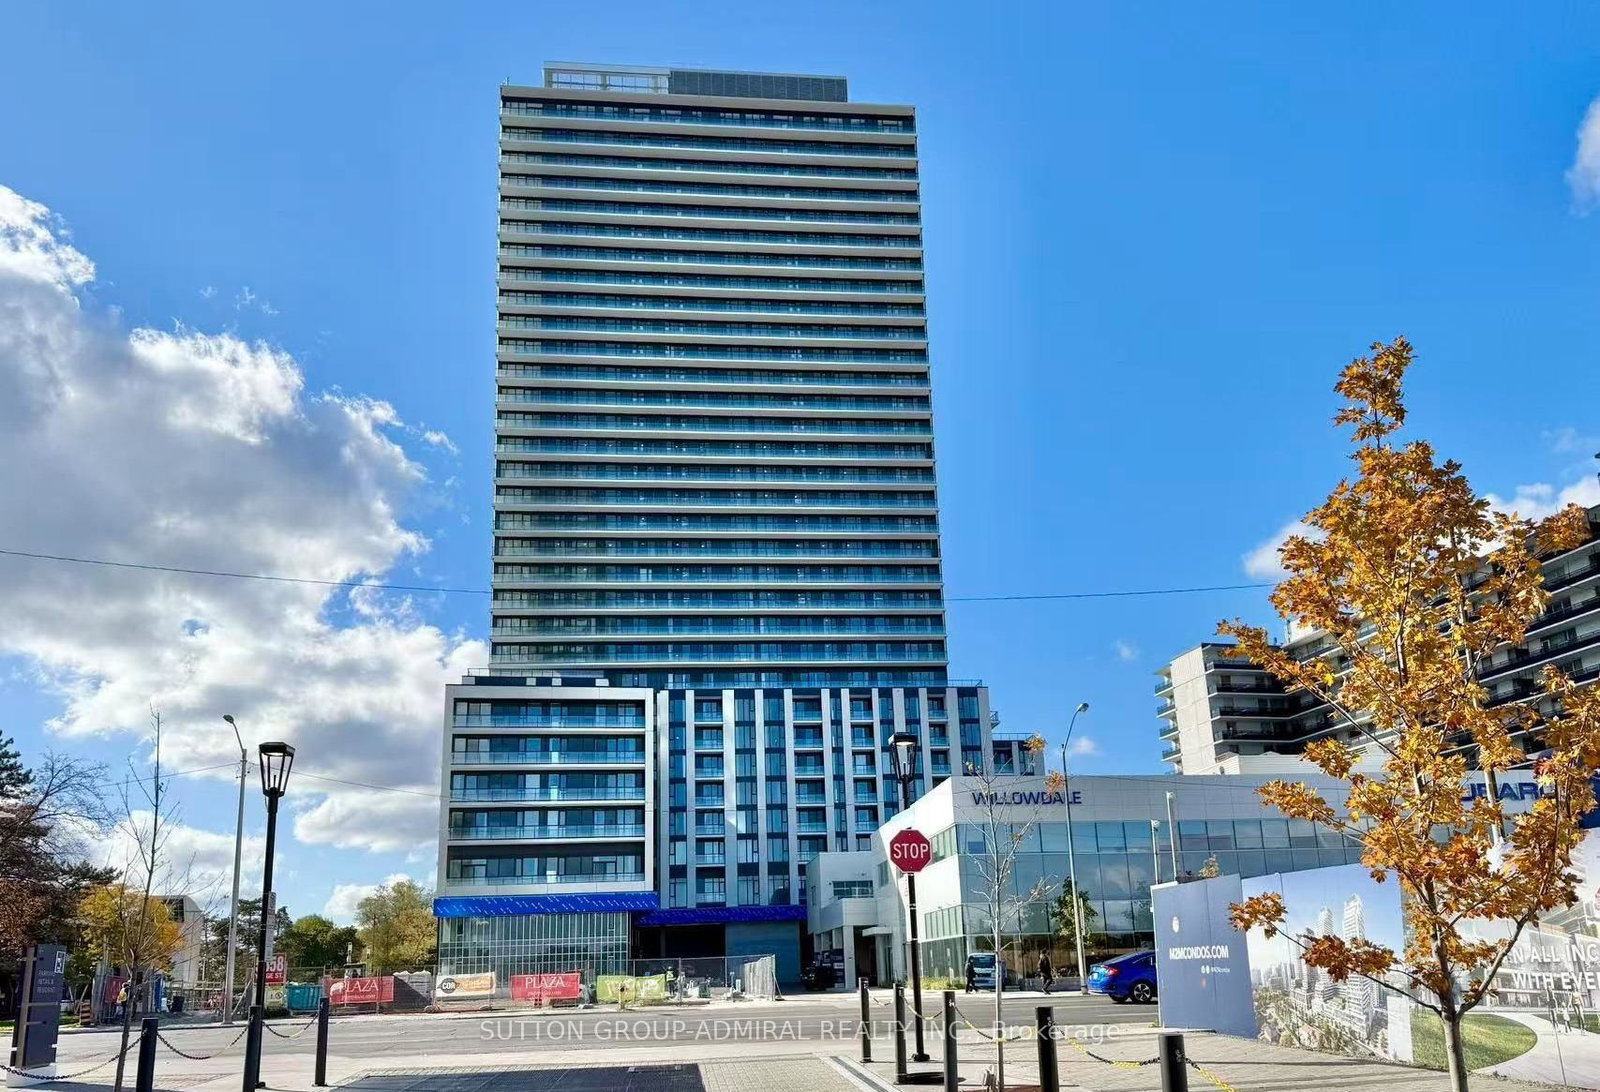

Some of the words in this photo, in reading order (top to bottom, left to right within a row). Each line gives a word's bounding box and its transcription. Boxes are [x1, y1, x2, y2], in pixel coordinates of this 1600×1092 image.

[893, 843, 928, 859] STOP
[1531, 946, 1560, 962] ALL
[345, 980, 379, 992] LAZA
[525, 976, 565, 989] PLAZA
[1512, 972, 1554, 989] WITH
